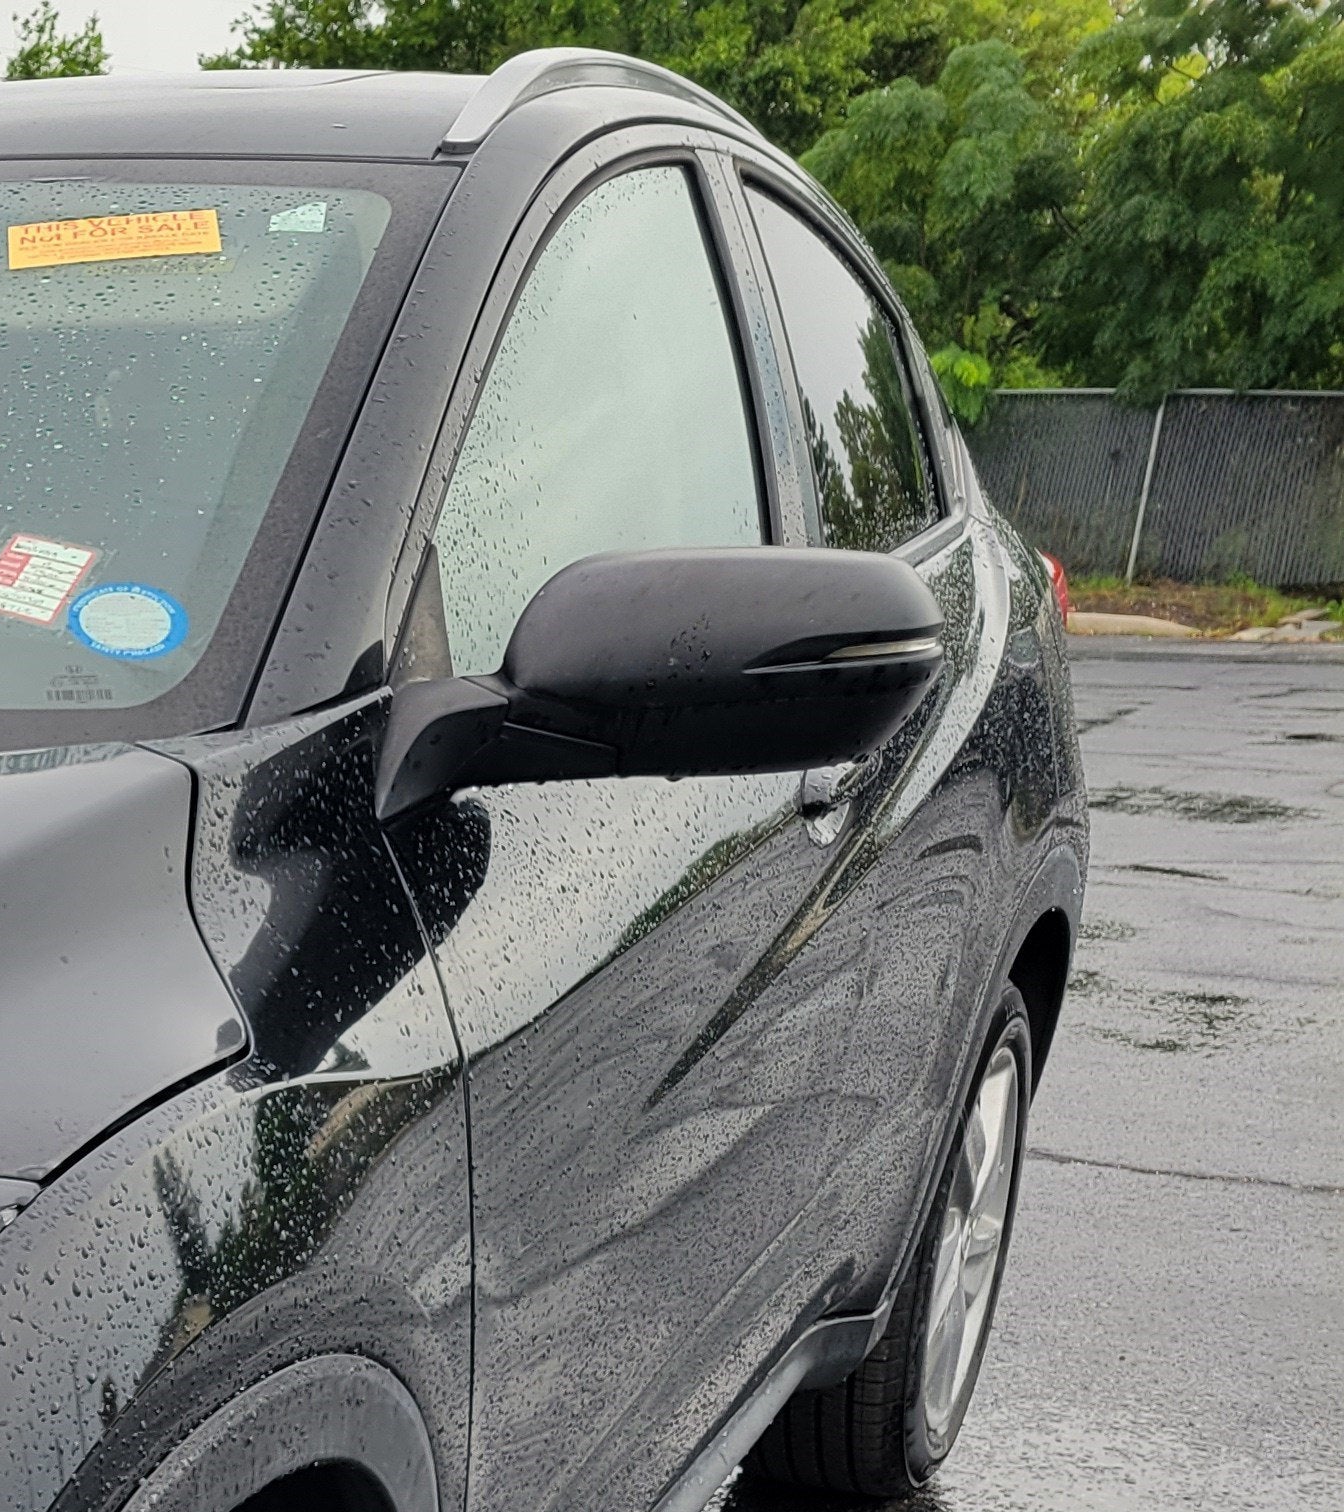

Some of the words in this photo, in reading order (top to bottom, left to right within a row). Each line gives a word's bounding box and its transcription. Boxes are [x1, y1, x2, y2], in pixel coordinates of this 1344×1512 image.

[21, 221, 79, 235] THIS
[88, 212, 204, 228] VEHICLE
[72, 226, 128, 239] FOR
[138, 221, 210, 234] SALE
